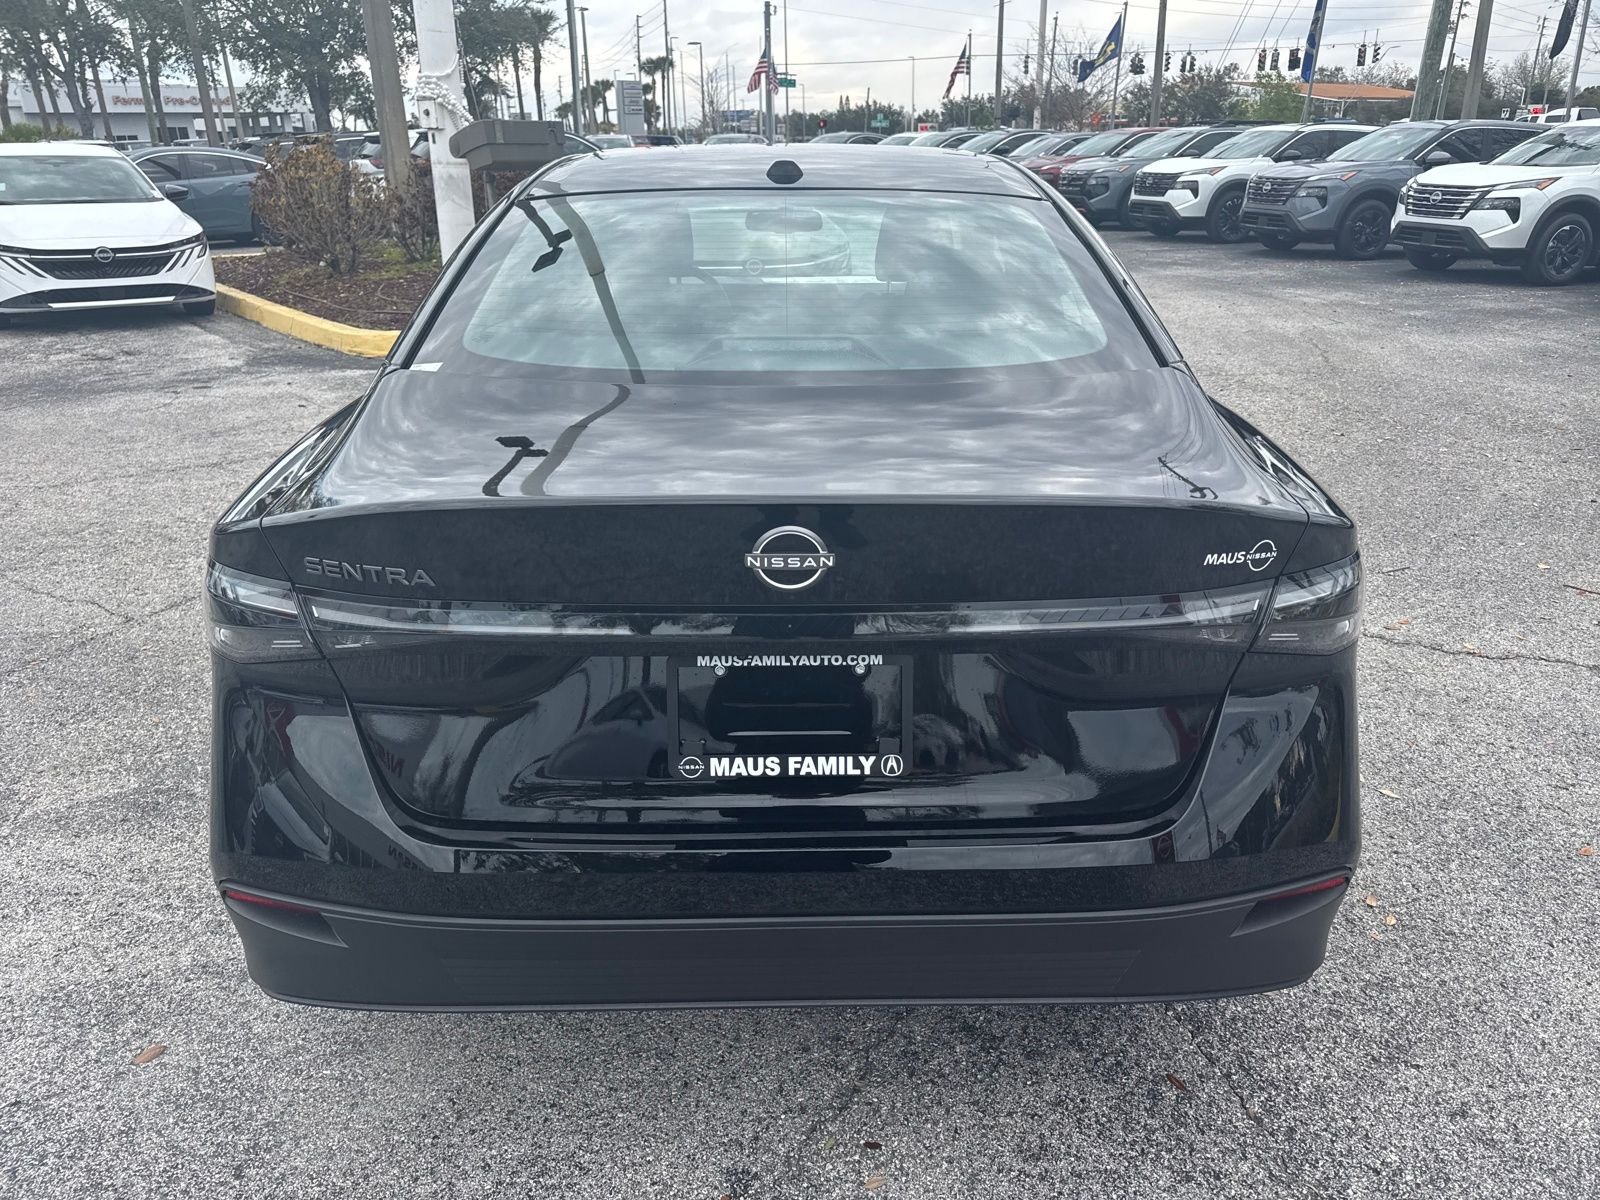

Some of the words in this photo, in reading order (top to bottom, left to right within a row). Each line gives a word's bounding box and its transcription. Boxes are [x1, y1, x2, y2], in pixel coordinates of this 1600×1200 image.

[163, 95, 231, 106] Pre-Ond
[747, 556, 833, 568] NISSAN
[1203, 551, 1246, 566] MAUS
[1246, 551, 1278, 560] NISSAN
[303, 556, 436, 587] SENTRA
[696, 655, 883, 666] MAUSFAMILYAUTO.COM
[709, 757, 781, 776] MAUS
[788, 756, 877, 775] FAMILY
